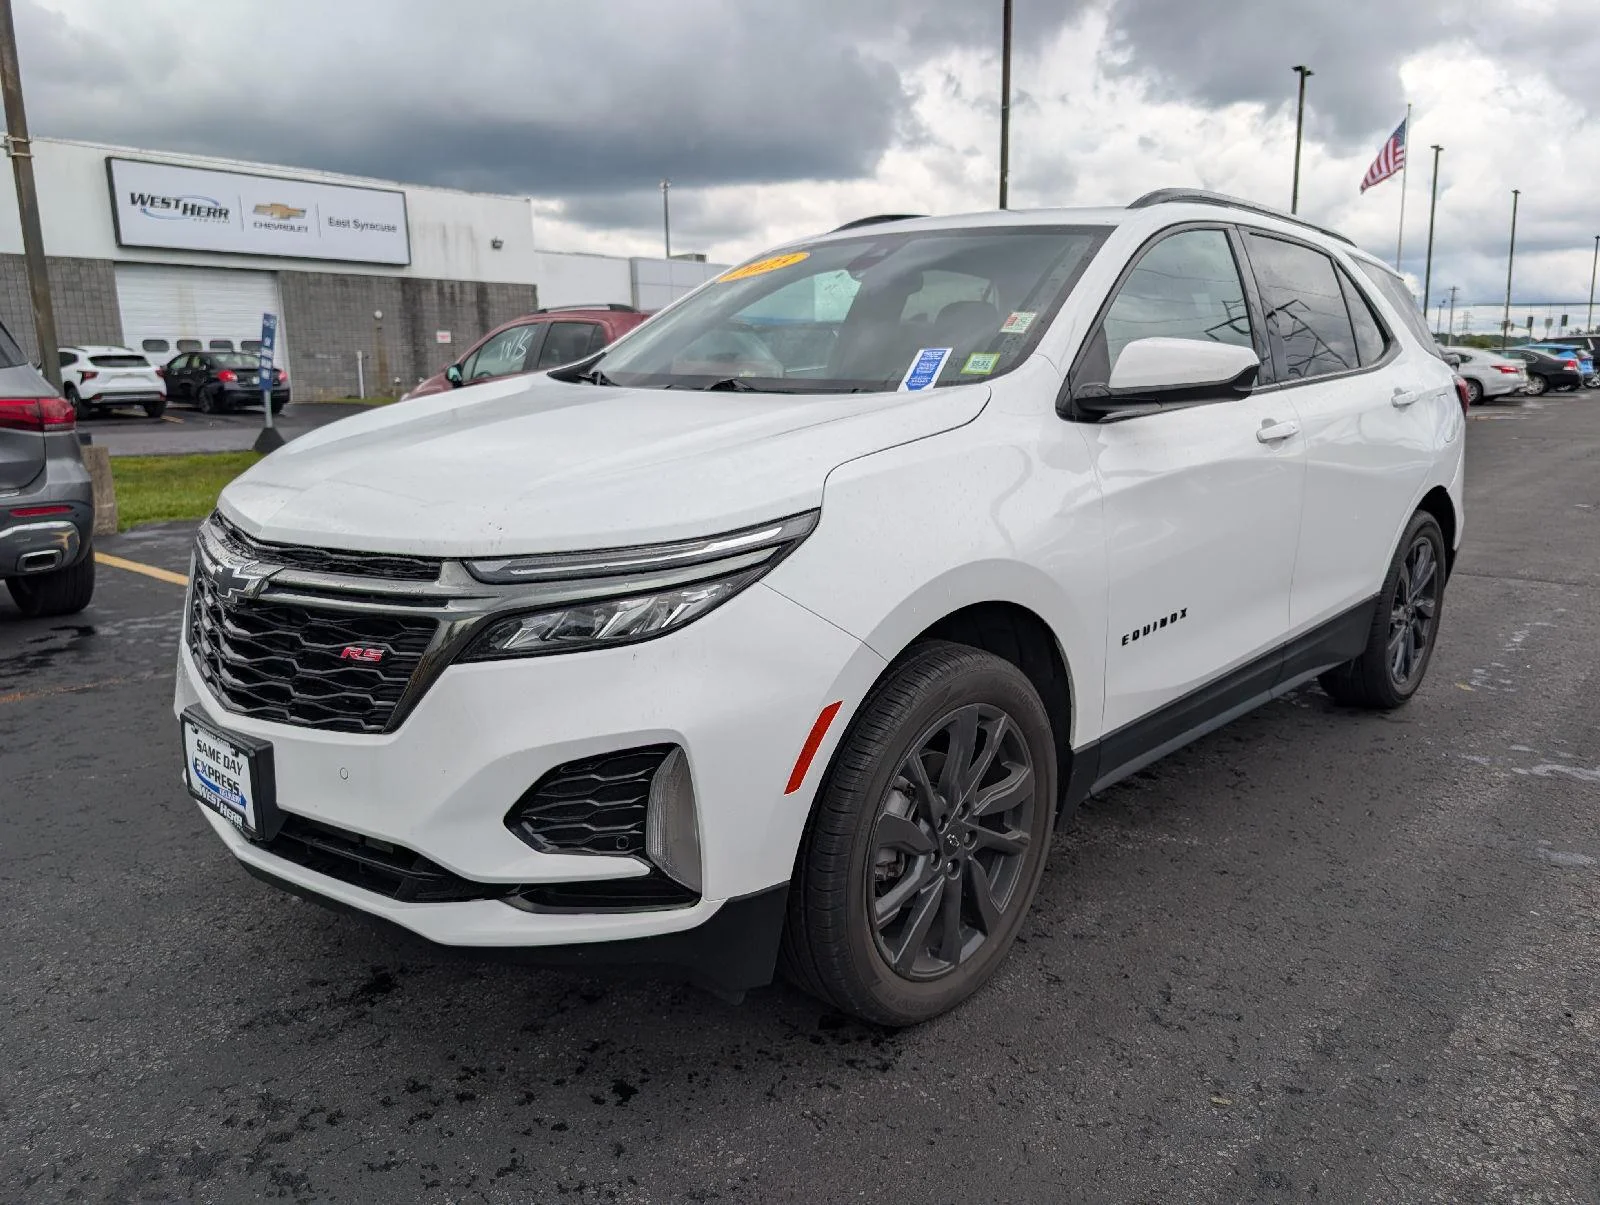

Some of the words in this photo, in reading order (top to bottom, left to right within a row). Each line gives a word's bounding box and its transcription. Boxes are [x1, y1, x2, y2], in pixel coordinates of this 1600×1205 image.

[129, 192, 182, 210] WEST
[181, 202, 230, 219] HERR
[253, 221, 309, 233] CHEVROLET
[328, 216, 351, 229] East
[353, 218, 398, 233] Syracuse
[1121, 607, 1188, 647] EQUINOX
[340, 646, 384, 662] RS
[196, 739, 221, 765] SAME
[223, 754, 244, 777] DAY
[195, 757, 241, 797] EXPRESS
[200, 784, 221, 808] WEST
